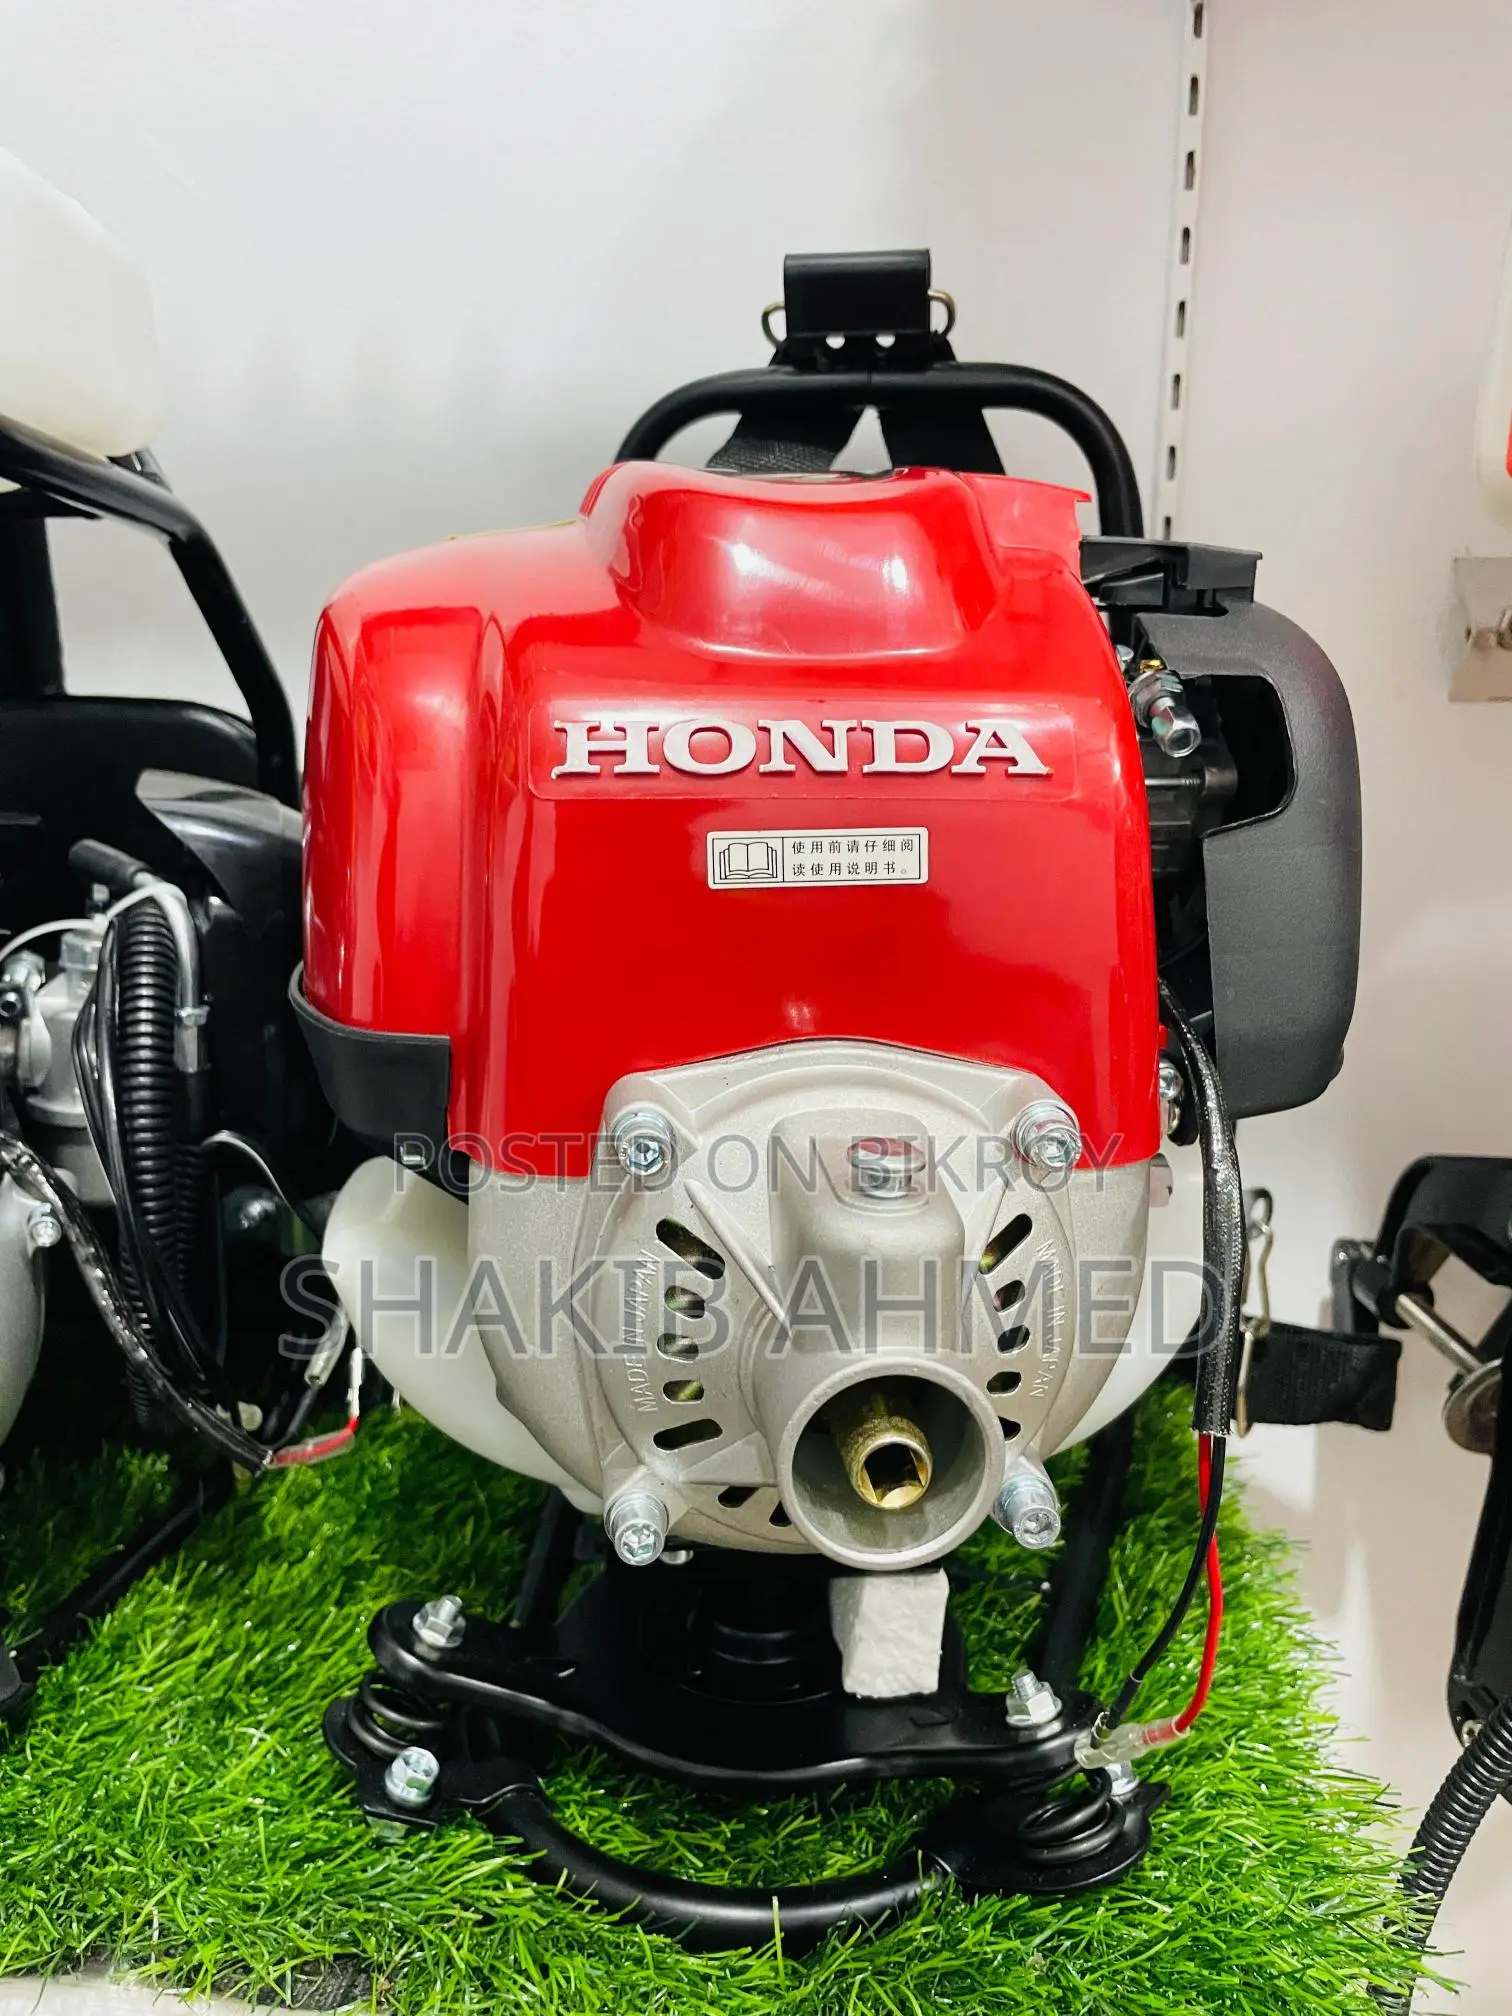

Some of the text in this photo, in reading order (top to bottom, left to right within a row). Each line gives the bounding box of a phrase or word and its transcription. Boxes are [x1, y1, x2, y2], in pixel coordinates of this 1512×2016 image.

[551, 718, 1054, 779] HONDA
[791, 838, 914, 856] 使用前请仔细阅
[791, 861, 908, 878] 读使用说明书。
